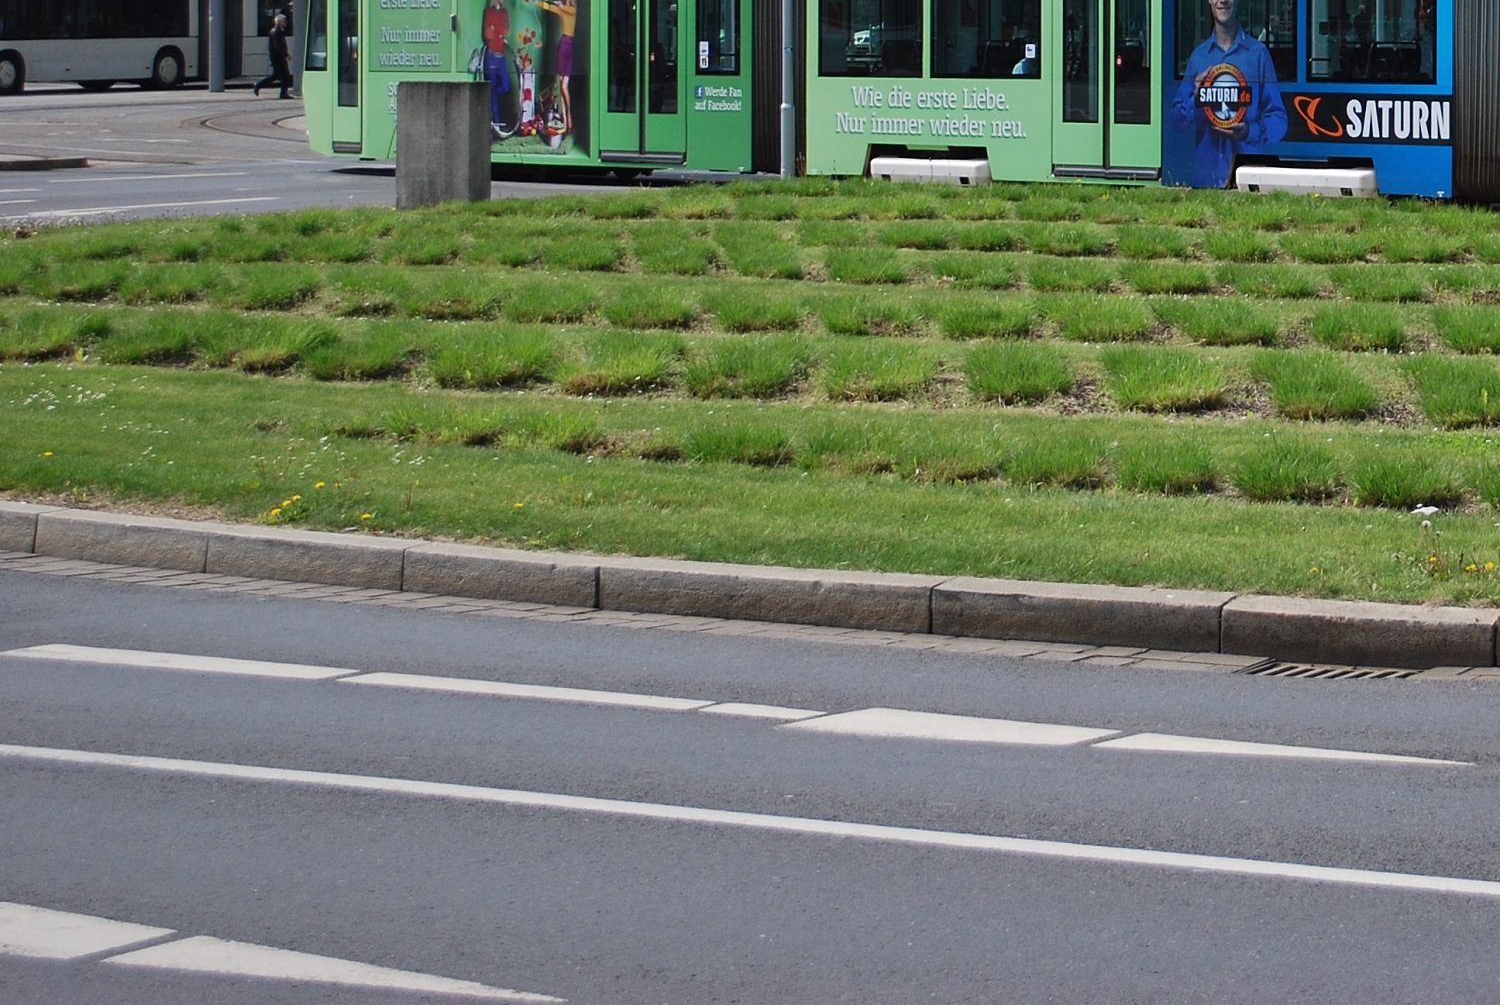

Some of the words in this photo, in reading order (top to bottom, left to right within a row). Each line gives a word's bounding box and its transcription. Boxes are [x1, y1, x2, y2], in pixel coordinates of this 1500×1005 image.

[380, 26, 401, 43] Nur
[404, 27, 441, 43] immer
[379, 48, 417, 67] wieder
[419, 51, 442, 67] neu.
[705, 86, 728, 97] Werde
[729, 86, 743, 98] Fan
[852, 85, 883, 109] Wie
[887, 85, 912, 109] die
[917, 89, 957, 110] erste
[962, 86, 1010, 110] Liebe.
[695, 99, 707, 111] auf
[708, 99, 742, 112] Facebook!
[836, 111, 867, 134] Nur
[871, 112, 925, 136] immer
[929, 113, 987, 138] wieder
[991, 119, 1027, 139] neu.
[1346, 98, 1451, 140] SATURN
